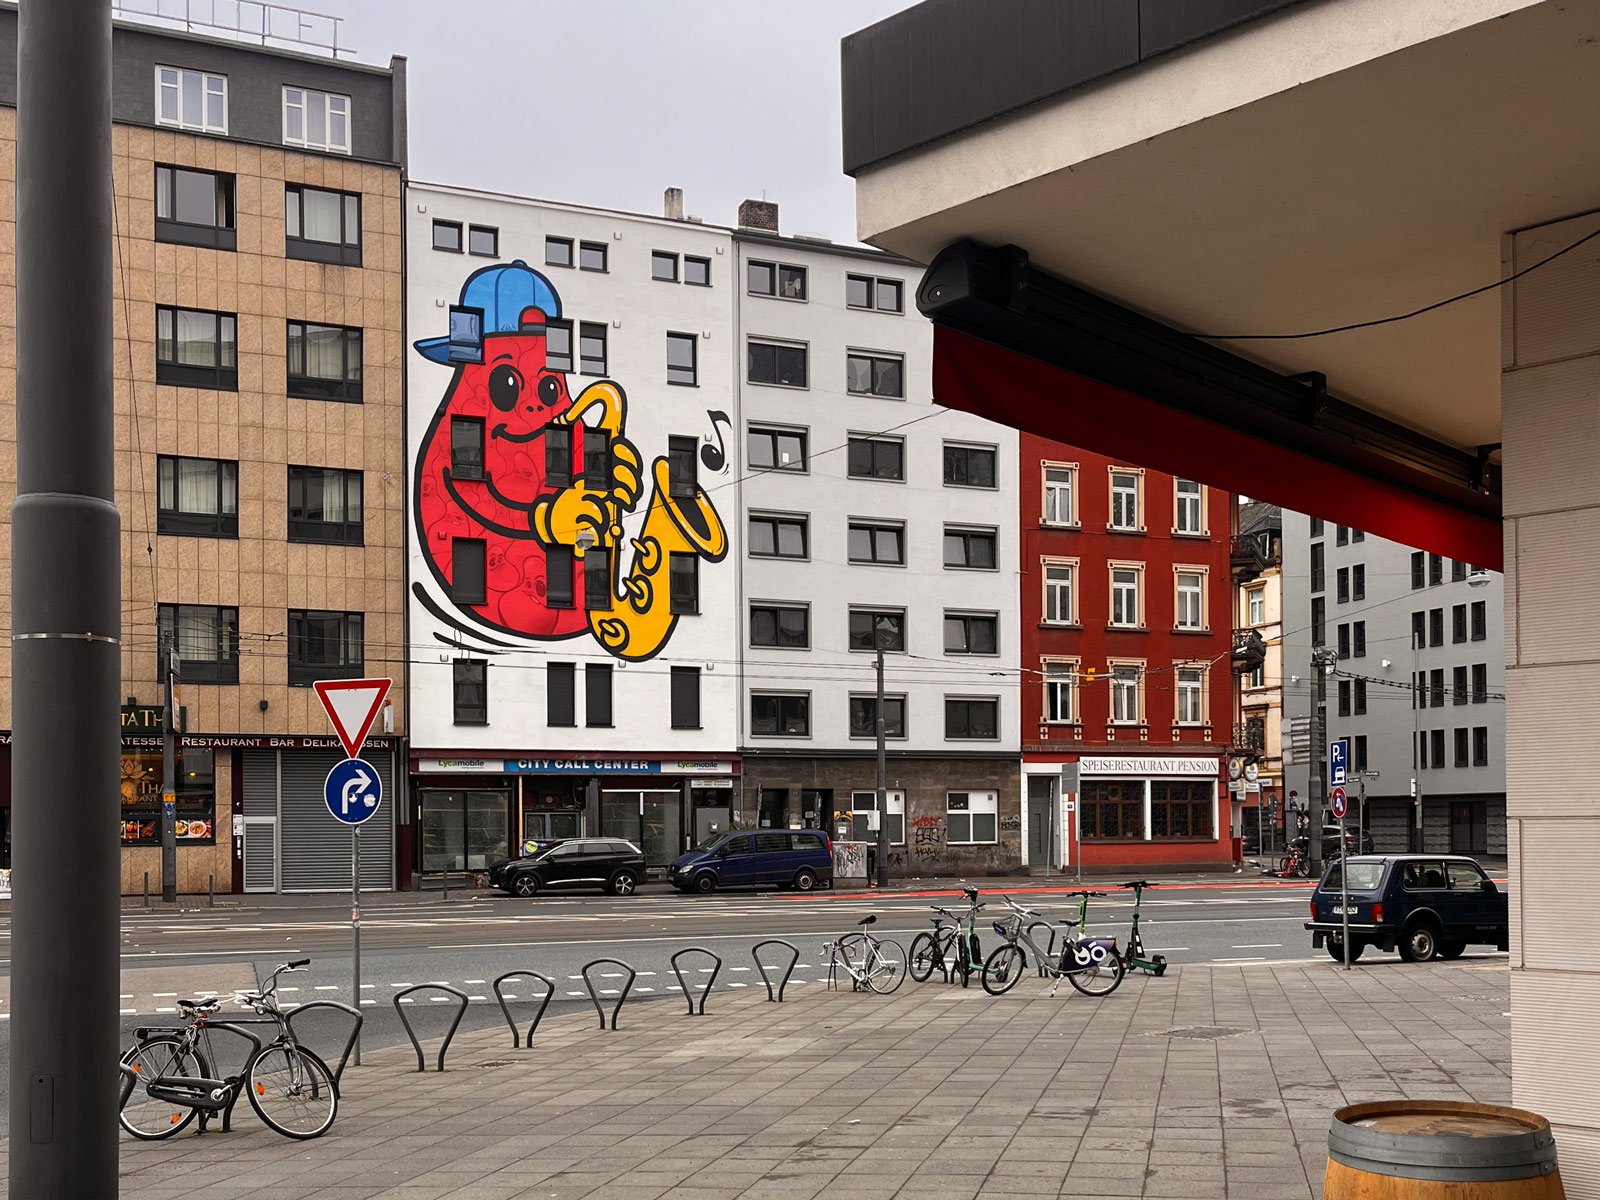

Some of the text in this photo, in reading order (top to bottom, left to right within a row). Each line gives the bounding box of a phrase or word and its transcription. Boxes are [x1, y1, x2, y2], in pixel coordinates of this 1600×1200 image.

[181, 737, 262, 746] RESTAURANT
[270, 738, 295, 747] BAR
[438, 759, 485, 768] Lycamobile
[517, 759, 649, 770] CITY CALL CENTER
[1082, 759, 1217, 772] SPEISERESTAURANT PENSION
